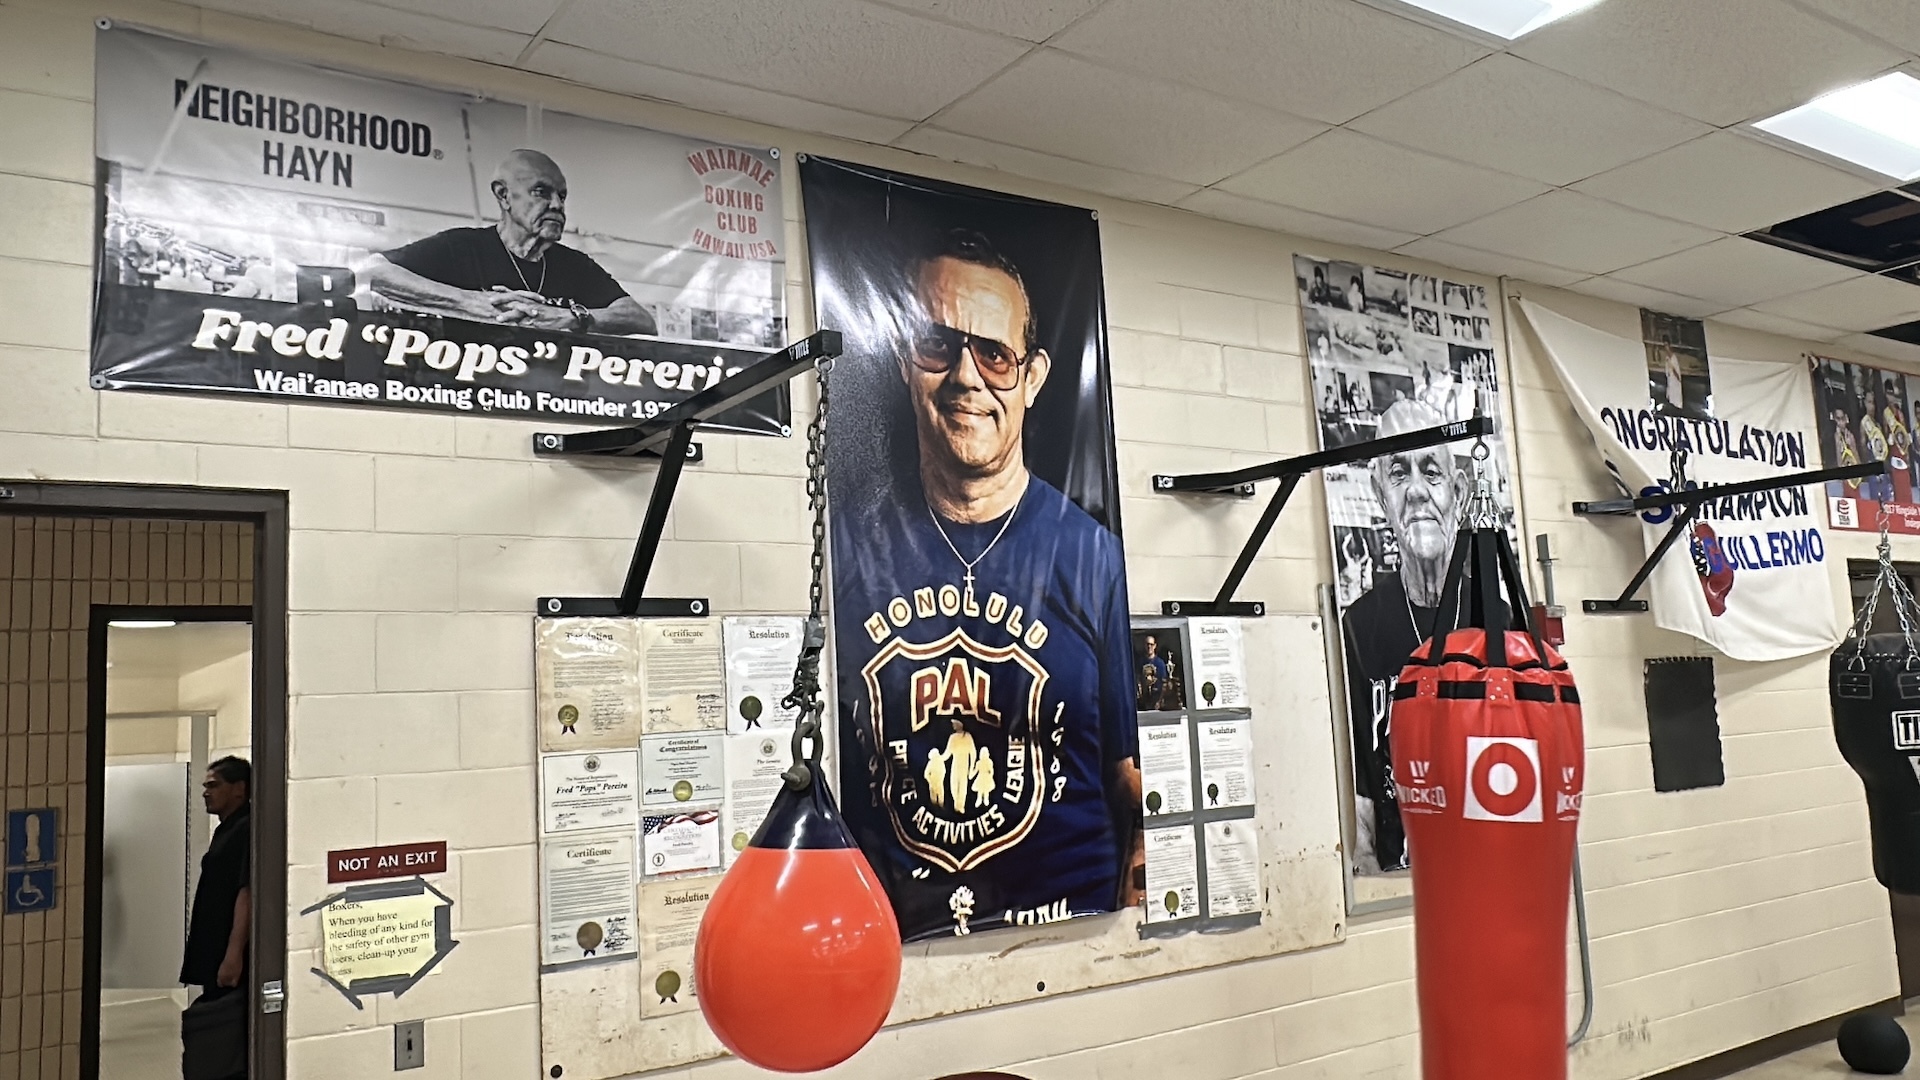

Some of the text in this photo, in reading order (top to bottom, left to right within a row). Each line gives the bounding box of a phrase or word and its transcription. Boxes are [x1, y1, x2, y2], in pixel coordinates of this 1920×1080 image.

[263, 140, 353, 188] HAYN
[687, 148, 775, 188] WAIANAE
[704, 184, 764, 212] BOXING
[717, 211, 758, 234] CLUB
[191, 308, 744, 391] Fred “Pops” Pereri
[385, 380, 473, 411] Boxing
[477, 387, 532, 411] Club
[536, 392, 627, 418] Founder
[632, 400, 679, 419] 197
[1449, 421, 1468, 436] TITLE
[1686, 480, 1808, 521] HAMPION
[864, 584, 1049, 650] HONOLULU
[663, 629, 704, 638] Certificate
[748, 629, 790, 639] Resolution
[911, 657, 1001, 733] PAL
[556, 785, 573, 794] Fred
[912, 805, 1005, 844] ACTIVITIES
[338, 851, 438, 871] NOT AN EXIT
[567, 847, 612, 858] Certificate
[664, 892, 710, 906] Resolution
[329, 912, 398, 927] When you have
[369, 925, 380, 934] of
[381, 925, 397, 933] any
[399, 920, 419, 931] kind
[421, 919, 433, 928] for
[345, 939, 372, 950] safety
[374, 936, 385, 946] of
[386, 934, 409, 945] other
[410, 933, 430, 943] gym
[357, 949, 396, 961] clean-up
[397, 946, 418, 957] your
